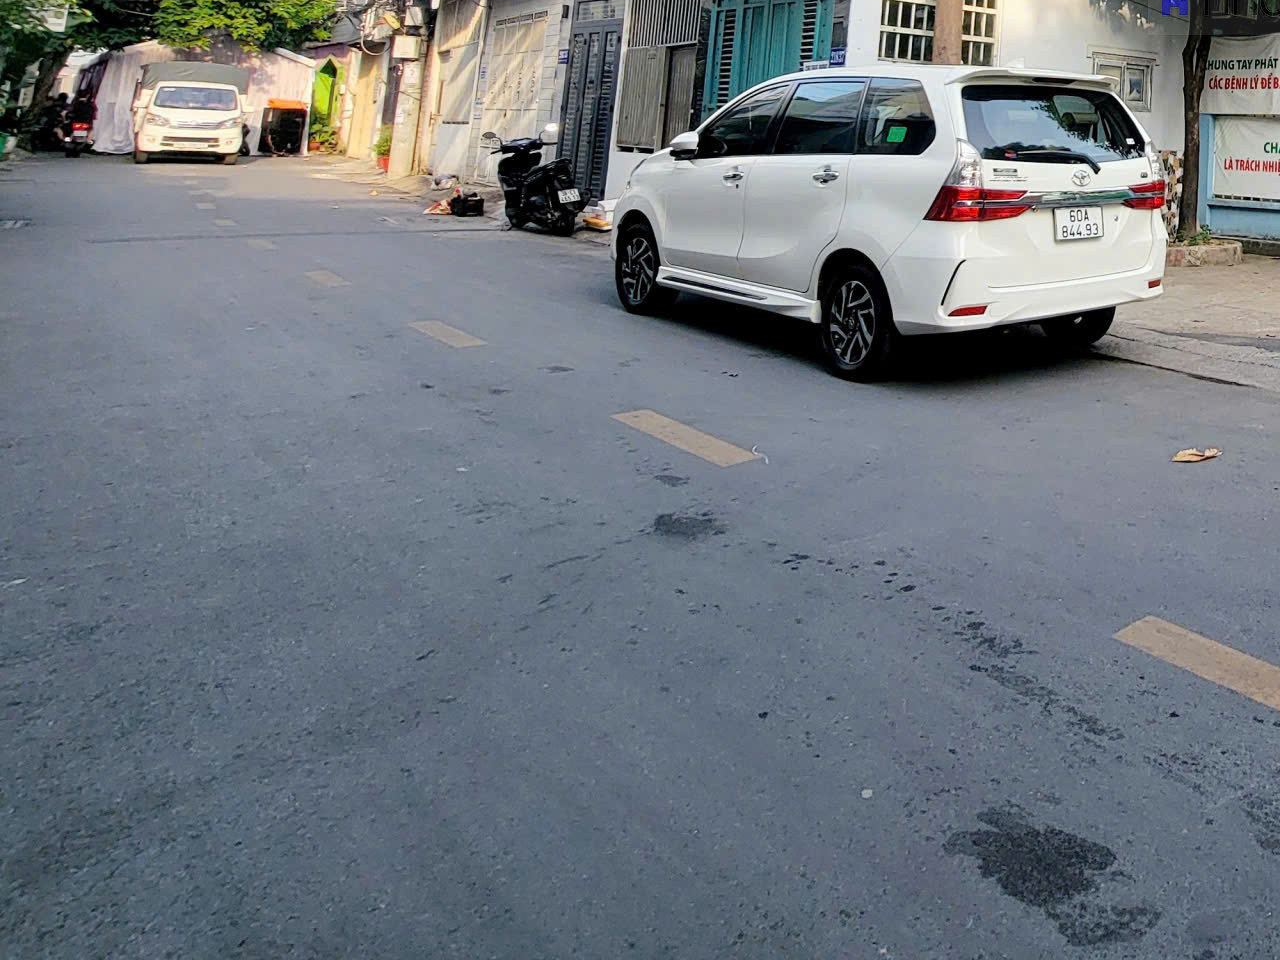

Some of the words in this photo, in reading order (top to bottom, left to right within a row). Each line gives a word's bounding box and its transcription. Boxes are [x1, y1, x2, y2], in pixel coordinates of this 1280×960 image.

[1207, 59, 1235, 70] HUNG
[1236, 59, 1253, 70] TAY
[1255, 56, 1279, 69] PHÁT
[1208, 75, 1223, 90] CÁC
[1225, 76, 1248, 93] BỆNH
[1249, 74, 1260, 89] LÝ
[1261, 72, 1273, 90] ĐỂ
[1224, 156, 1234, 170] LÀ
[1235, 157, 1260, 172] TRÁCH
[1069, 209, 1090, 223] 60A
[1062, 223, 1099, 239] 844.93
